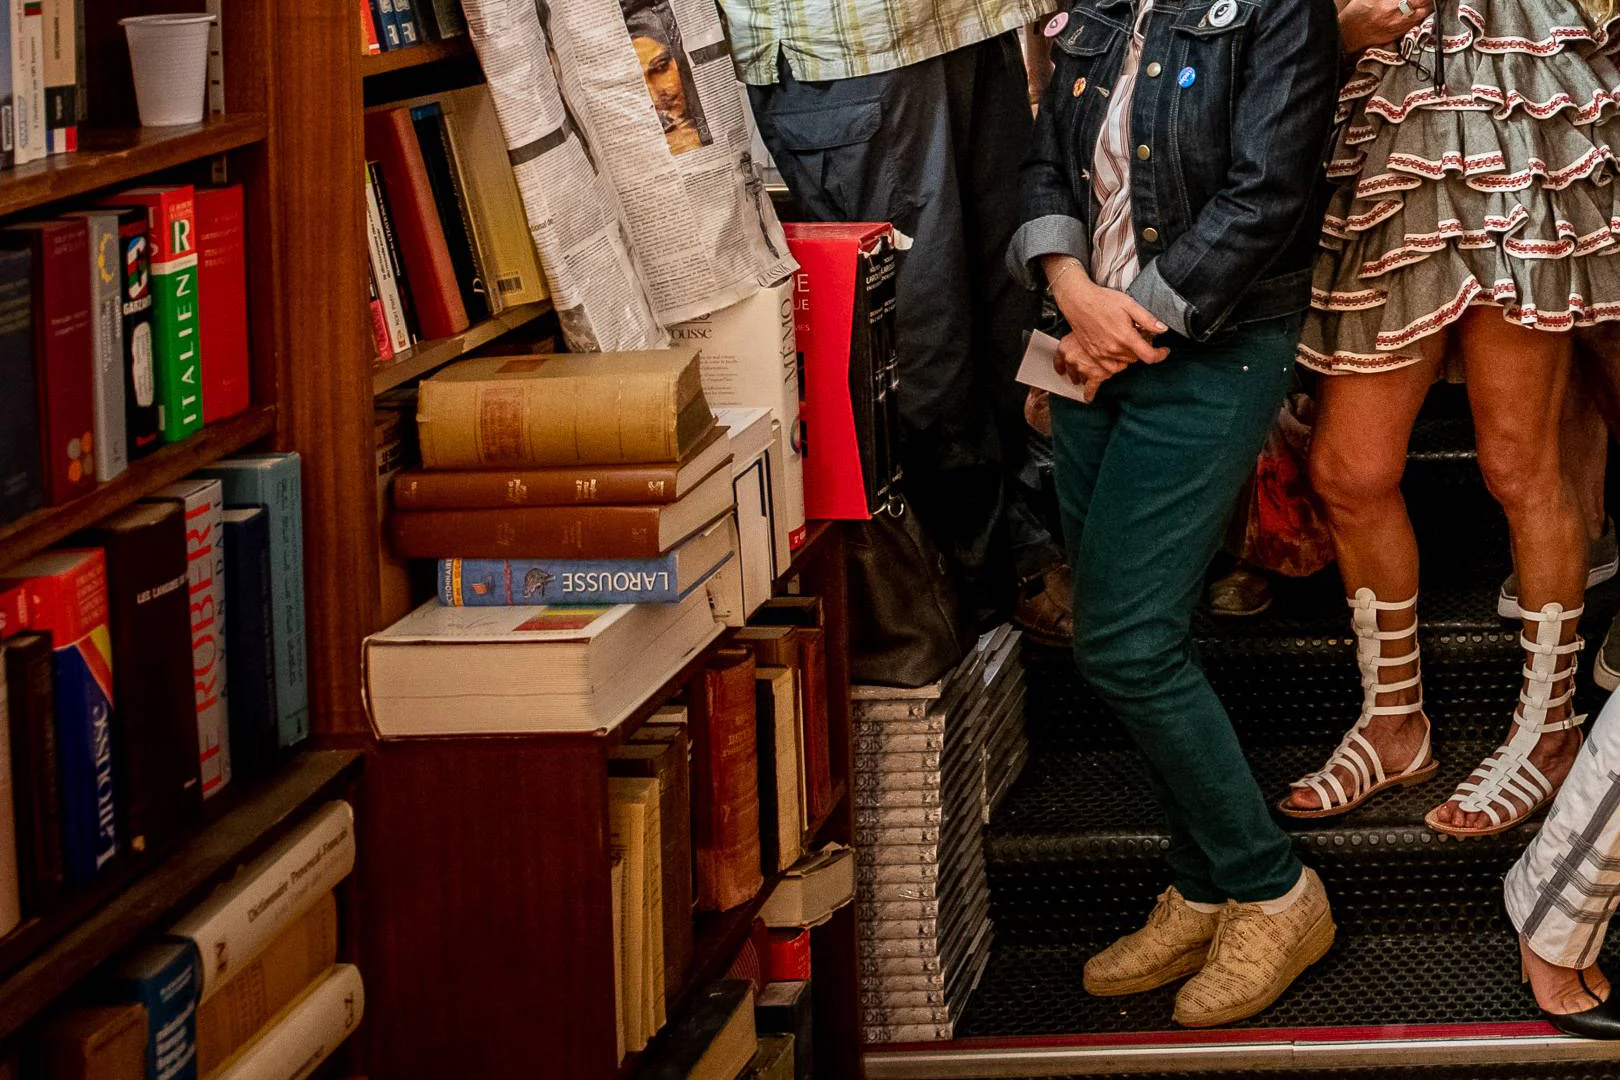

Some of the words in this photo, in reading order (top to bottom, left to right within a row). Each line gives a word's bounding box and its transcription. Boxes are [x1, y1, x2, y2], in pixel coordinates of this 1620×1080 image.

[176, 274, 197, 425] ITALIEN
[779, 297, 799, 384] MÉMO
[185, 500, 217, 715] ROBERT
[562, 570, 671, 592] LAROUSSE
[95, 704, 120, 869] Larousse
[200, 726, 222, 793] LE
